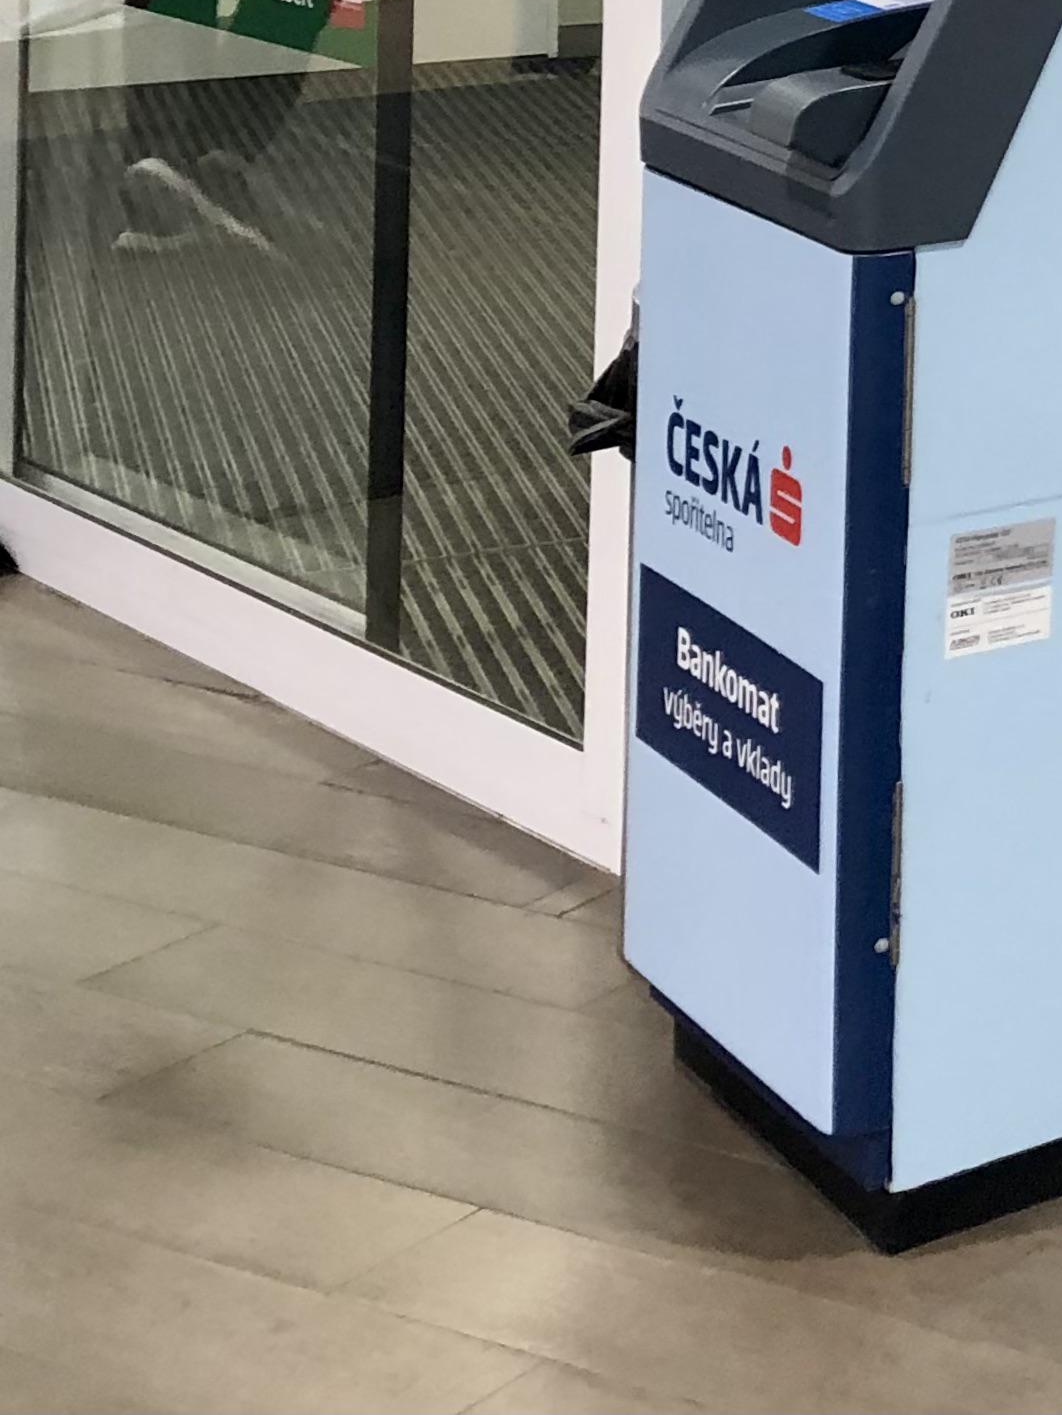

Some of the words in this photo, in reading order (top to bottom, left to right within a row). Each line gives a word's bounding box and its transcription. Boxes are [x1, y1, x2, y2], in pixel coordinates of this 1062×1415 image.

[667, 395, 763, 525] ČESKÁ
[665, 490, 734, 552] spořitelna
[950, 607, 975, 619] OKI
[677, 626, 780, 733] Bankomat
[664, 687, 718, 754] výběry
[722, 730, 732, 759] a
[736, 738, 792, 809] vklady
